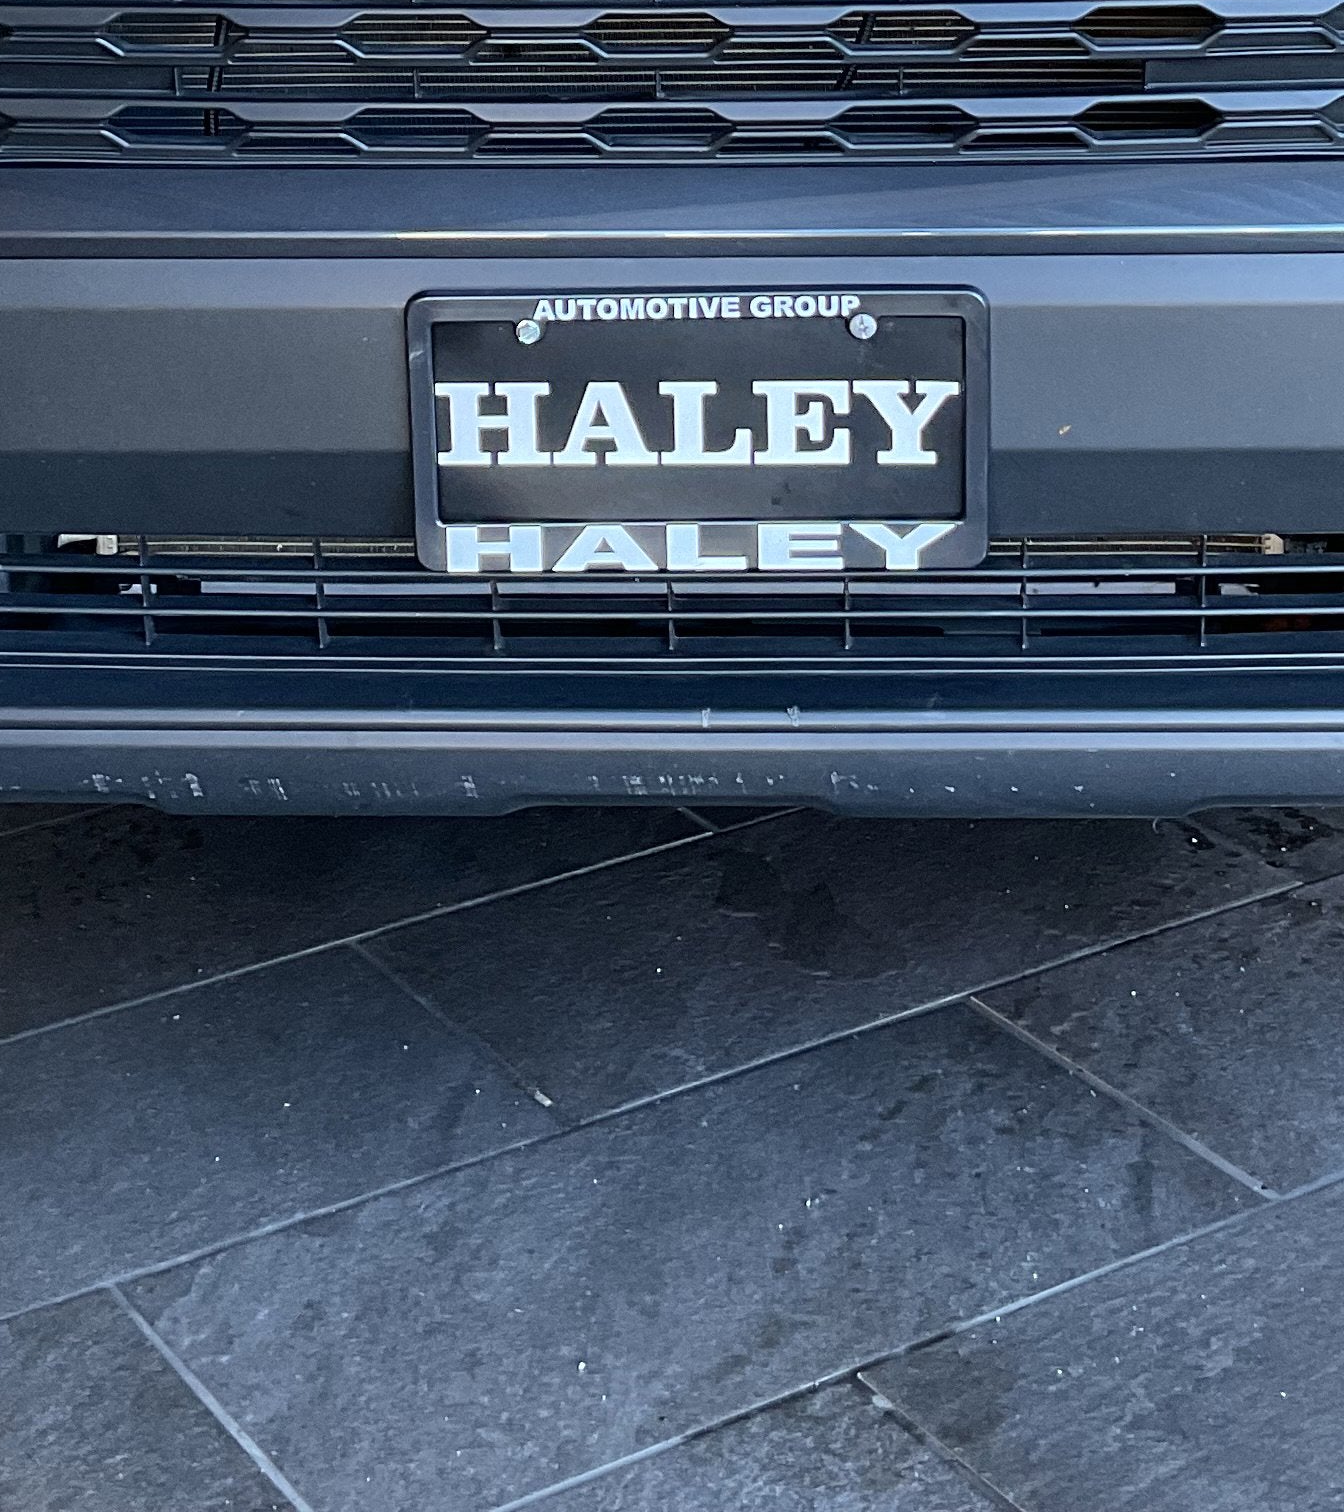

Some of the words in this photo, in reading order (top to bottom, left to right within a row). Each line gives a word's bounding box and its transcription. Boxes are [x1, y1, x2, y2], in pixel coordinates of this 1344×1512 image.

[532, 296, 741, 321] AUTOMOTIVE
[749, 294, 861, 319] GROUP
[434, 380, 959, 465] HALEY
[445, 522, 957, 573] HALEY
